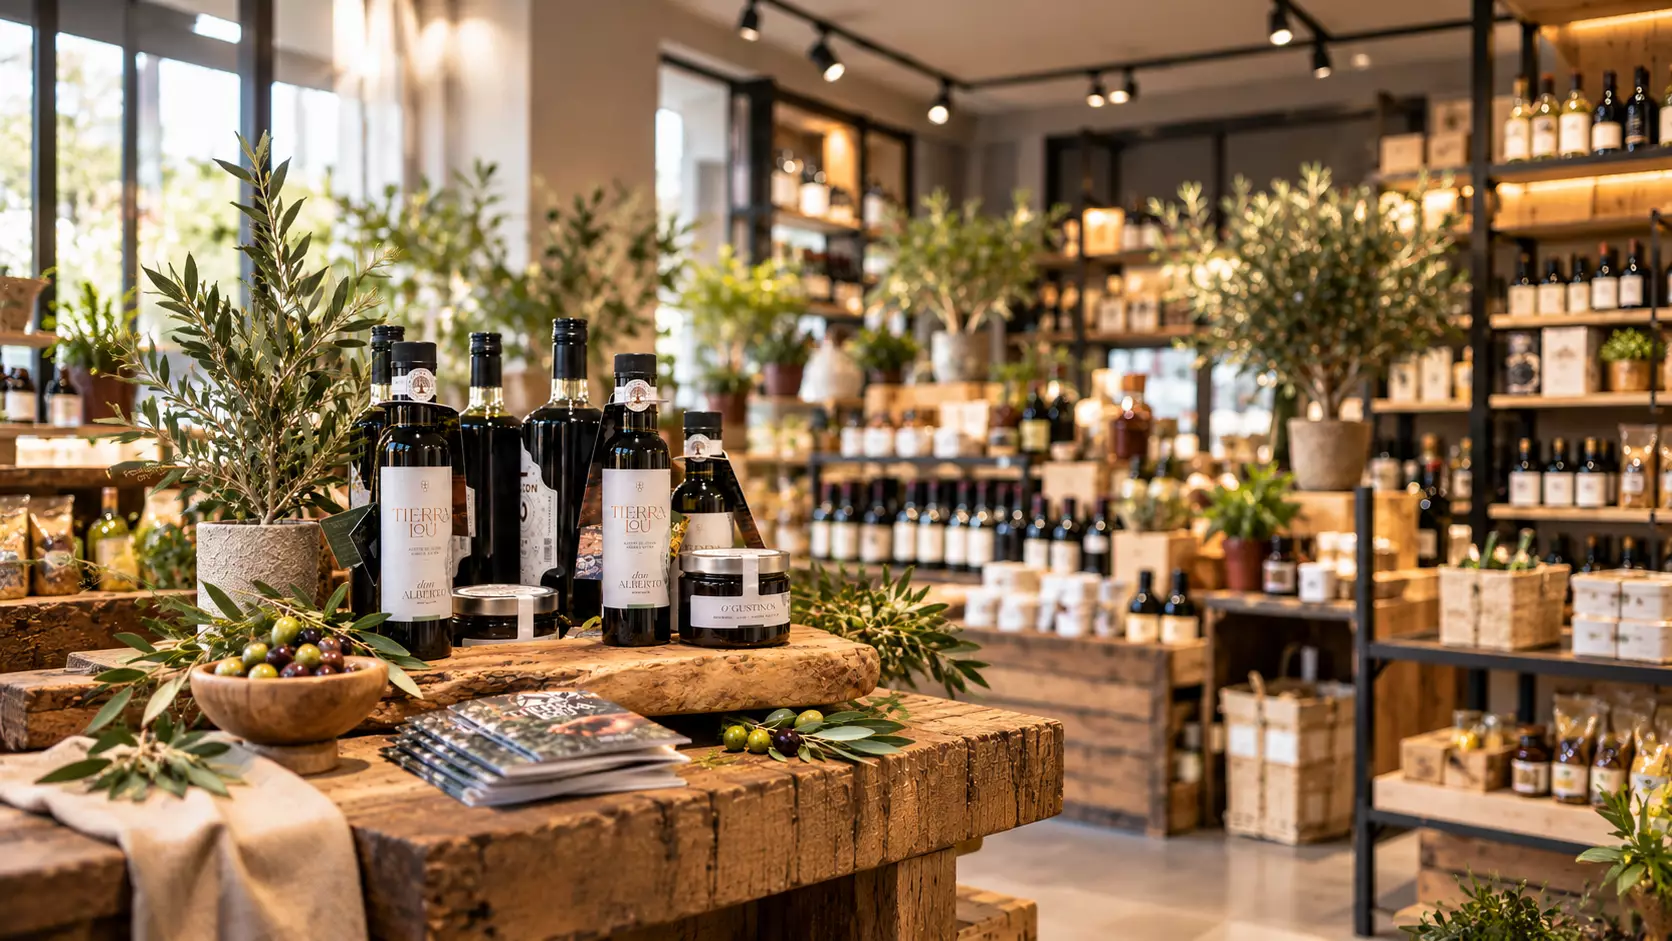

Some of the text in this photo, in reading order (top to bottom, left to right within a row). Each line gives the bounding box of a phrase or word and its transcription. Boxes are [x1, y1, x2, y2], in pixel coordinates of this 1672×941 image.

[391, 507, 450, 524] TIERRA
[610, 505, 667, 521] TIERRA
[410, 523, 437, 538] LOU
[626, 519, 651, 533] LOU
[631, 571, 649, 579] don
[618, 579, 662, 589] ALBERTO
[401, 588, 447, 600] ALBERTO
